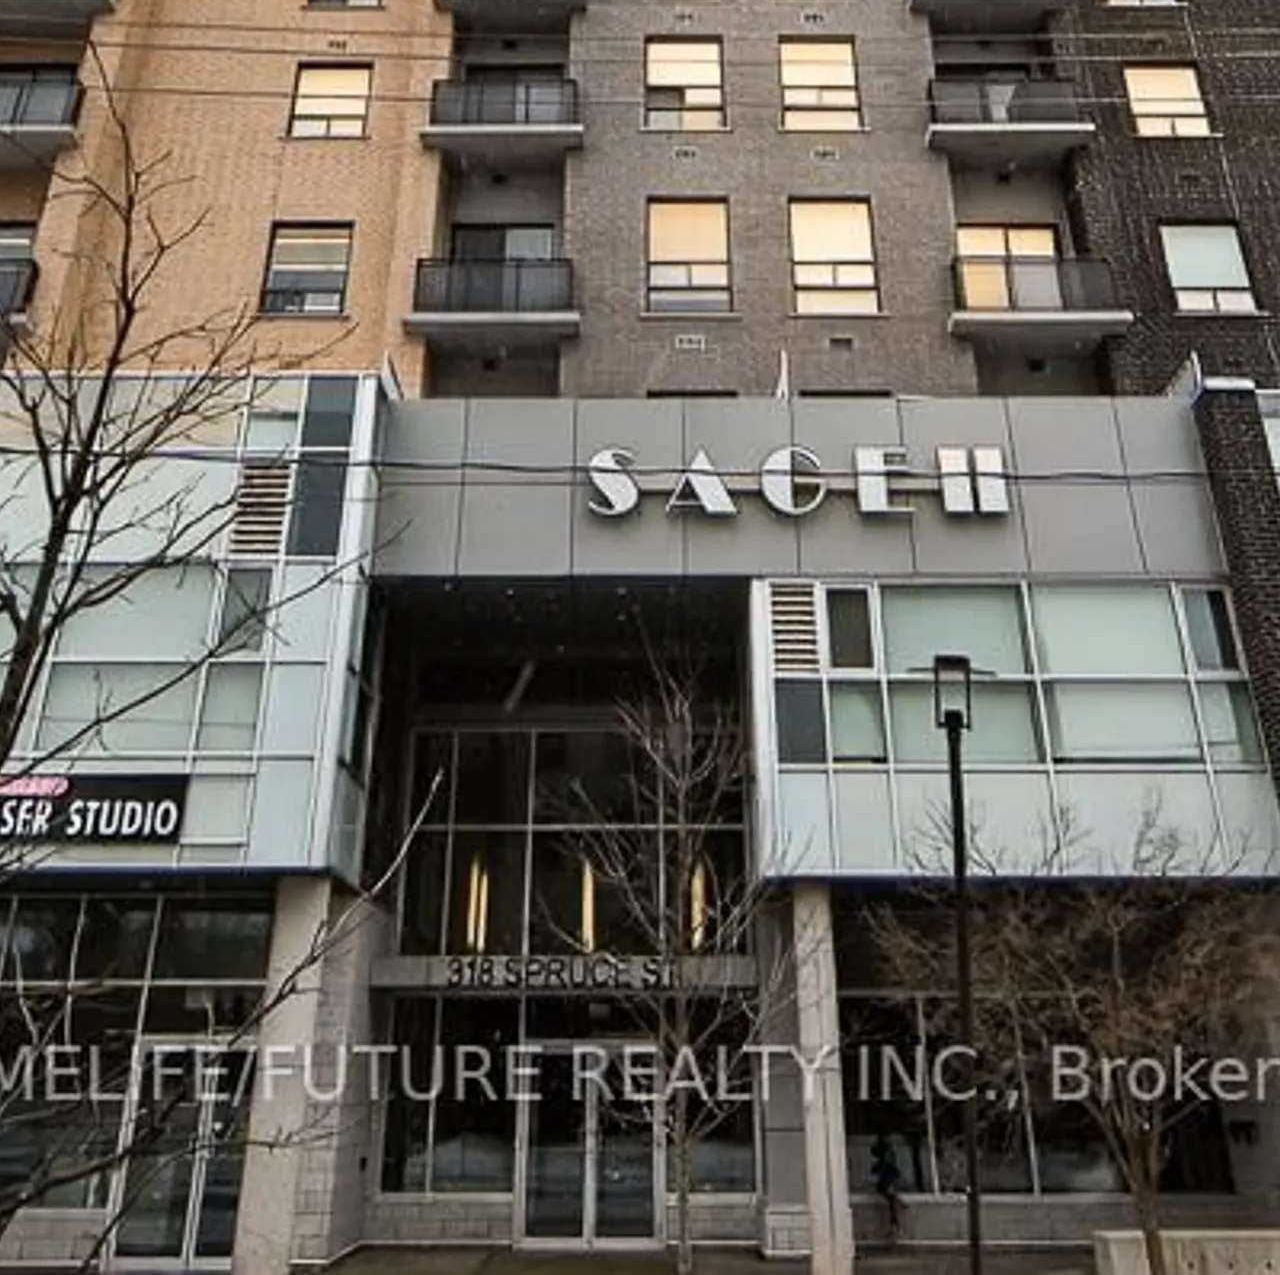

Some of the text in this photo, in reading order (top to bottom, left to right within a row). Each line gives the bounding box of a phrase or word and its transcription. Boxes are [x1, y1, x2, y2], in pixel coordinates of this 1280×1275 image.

[587, 444, 917, 518] SAGE
[66, 798, 179, 836] STUDIO
[447, 957, 495, 988] 318
[505, 957, 632, 988] SPRUCE
